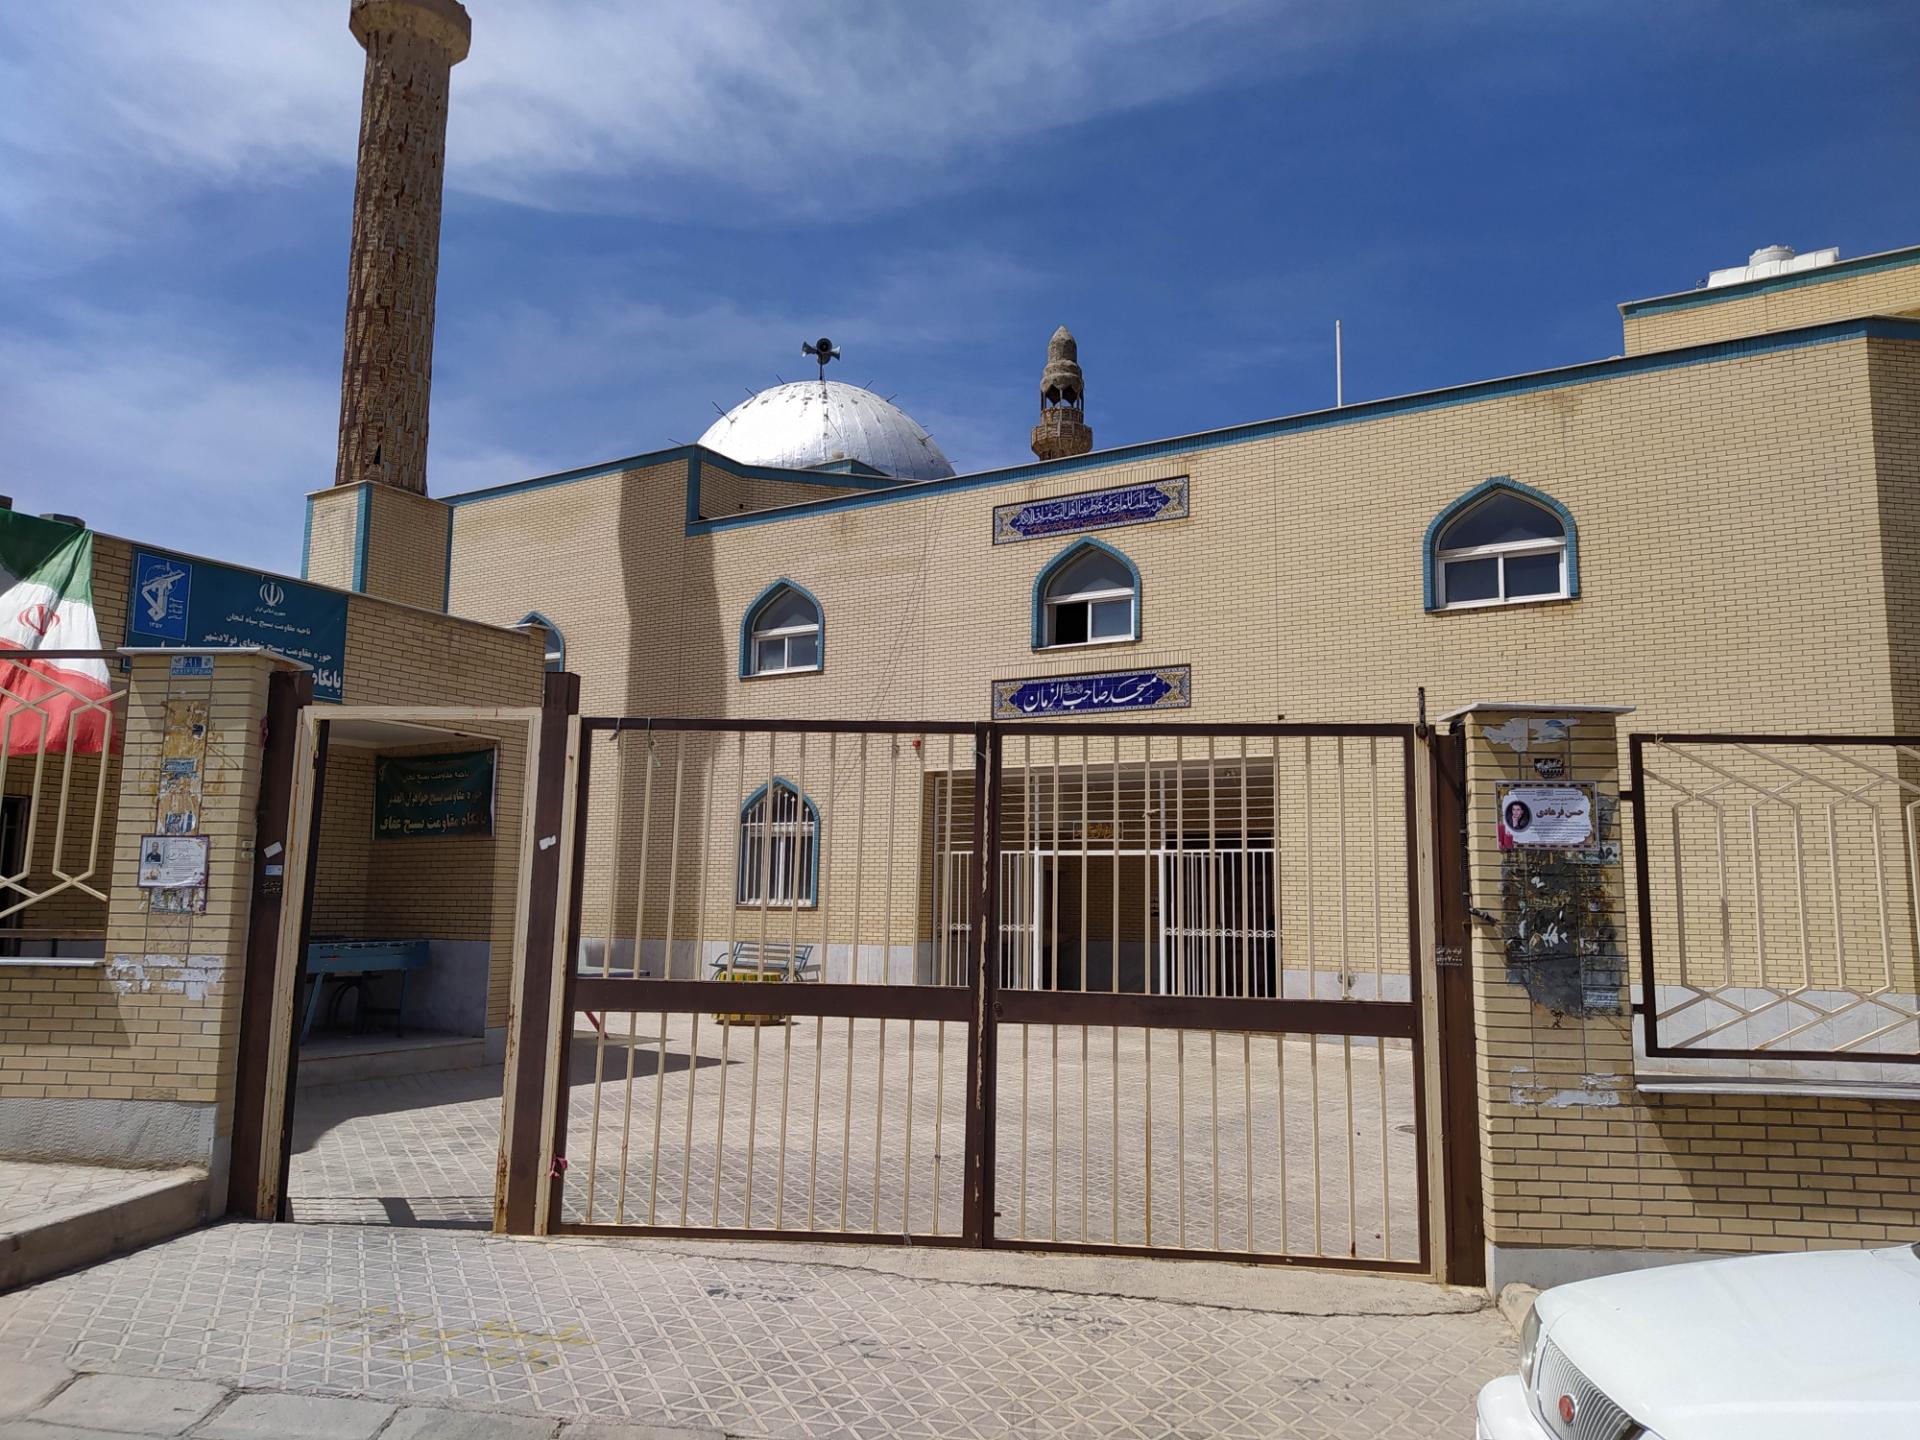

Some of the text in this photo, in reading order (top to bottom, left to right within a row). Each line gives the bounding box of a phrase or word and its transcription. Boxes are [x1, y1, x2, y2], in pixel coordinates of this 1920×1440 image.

[258, 620, 273, 628] بسیج
[274, 623, 296, 633] مقاومت
[266, 643, 284, 655] بسیج
[285, 647, 312, 658] مقاومت
[313, 651, 332, 662] حوزه
[312, 668, 341, 695] پایگاه
[1062, 679, 1109, 710] صاحب
[1105, 676, 1158, 703] مسجد
[1565, 809, 1584, 819] حسن
[403, 817, 425, 834] بسیج
[427, 813, 459, 833] مقاومت
